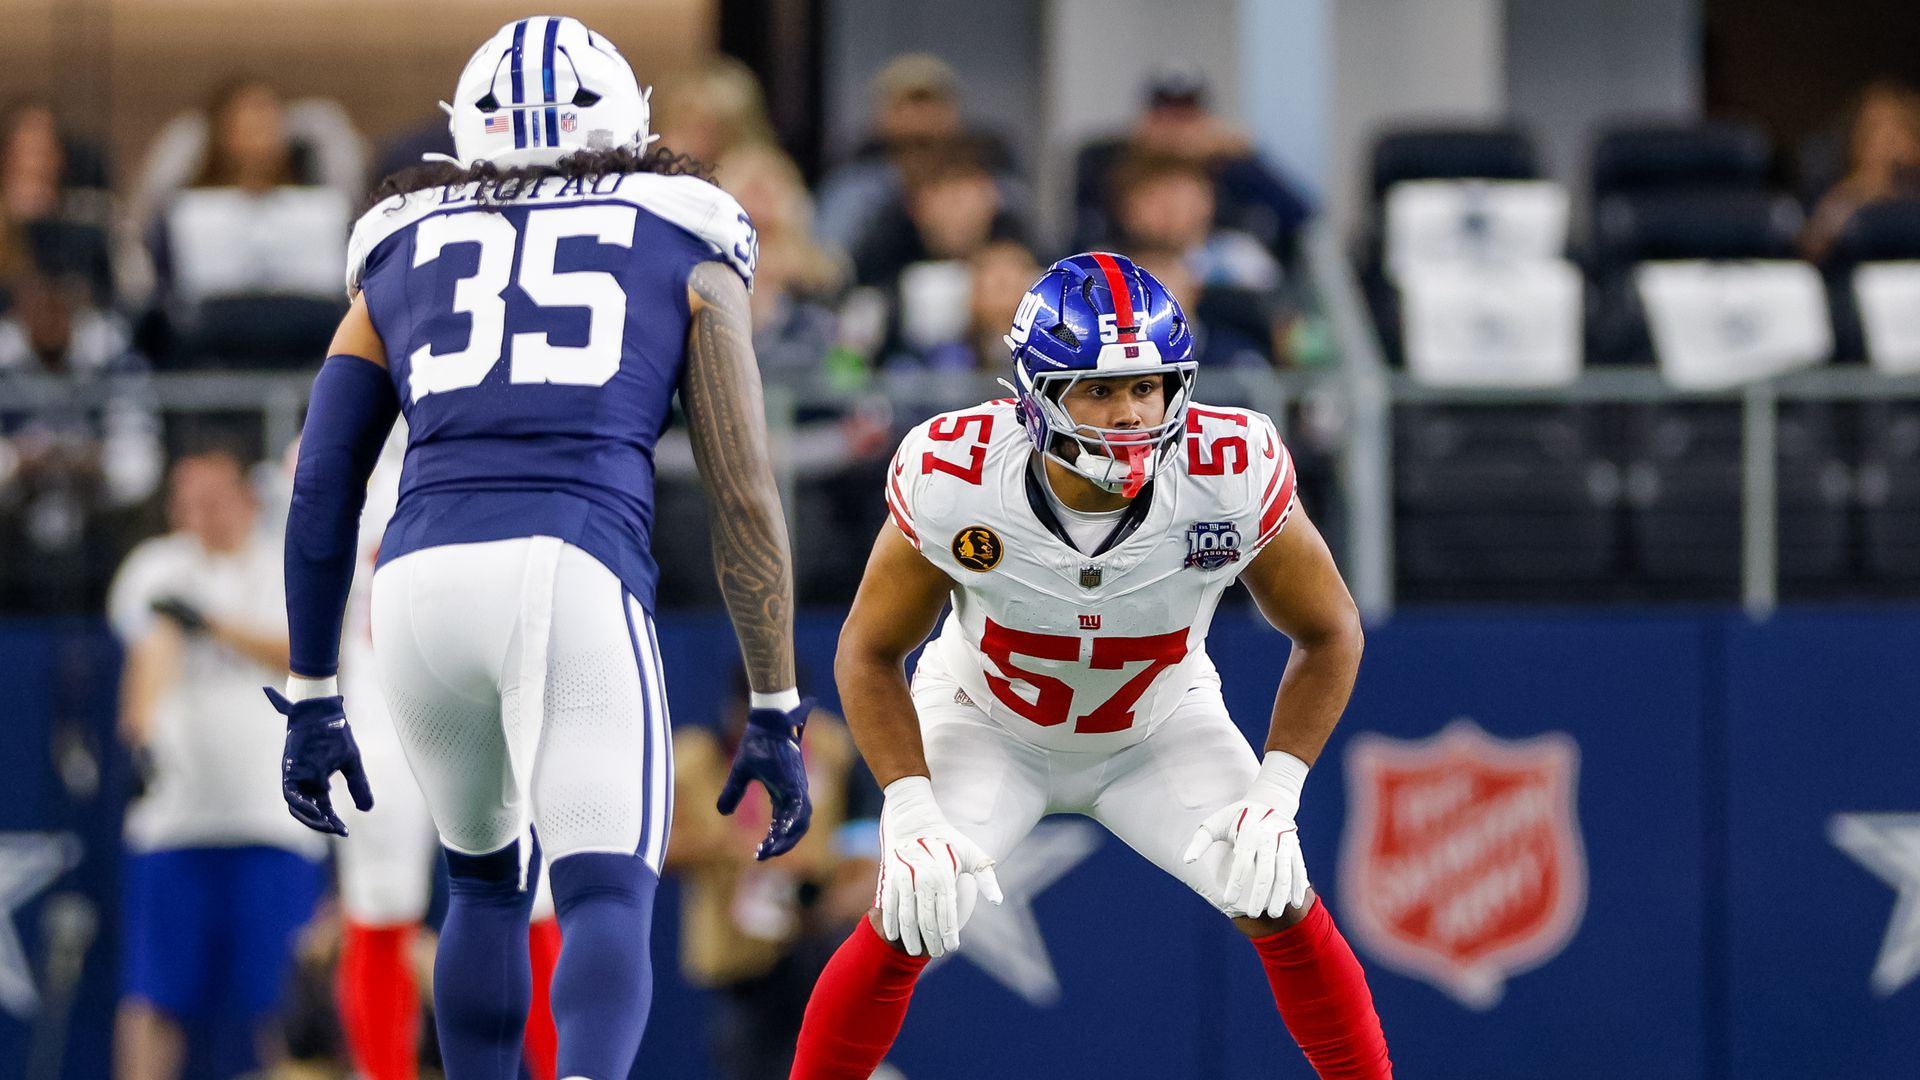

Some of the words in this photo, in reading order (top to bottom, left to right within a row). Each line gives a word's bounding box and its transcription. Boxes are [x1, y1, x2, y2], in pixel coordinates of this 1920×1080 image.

[409, 204, 638, 405] 35
[1100, 312, 1149, 344] 57
[922, 414, 994, 486] 57
[1187, 408, 1249, 476] 57
[1188, 531, 1240, 554] 100
[1191, 550, 1234, 560] SEASONS
[980, 615, 1191, 734] 57
